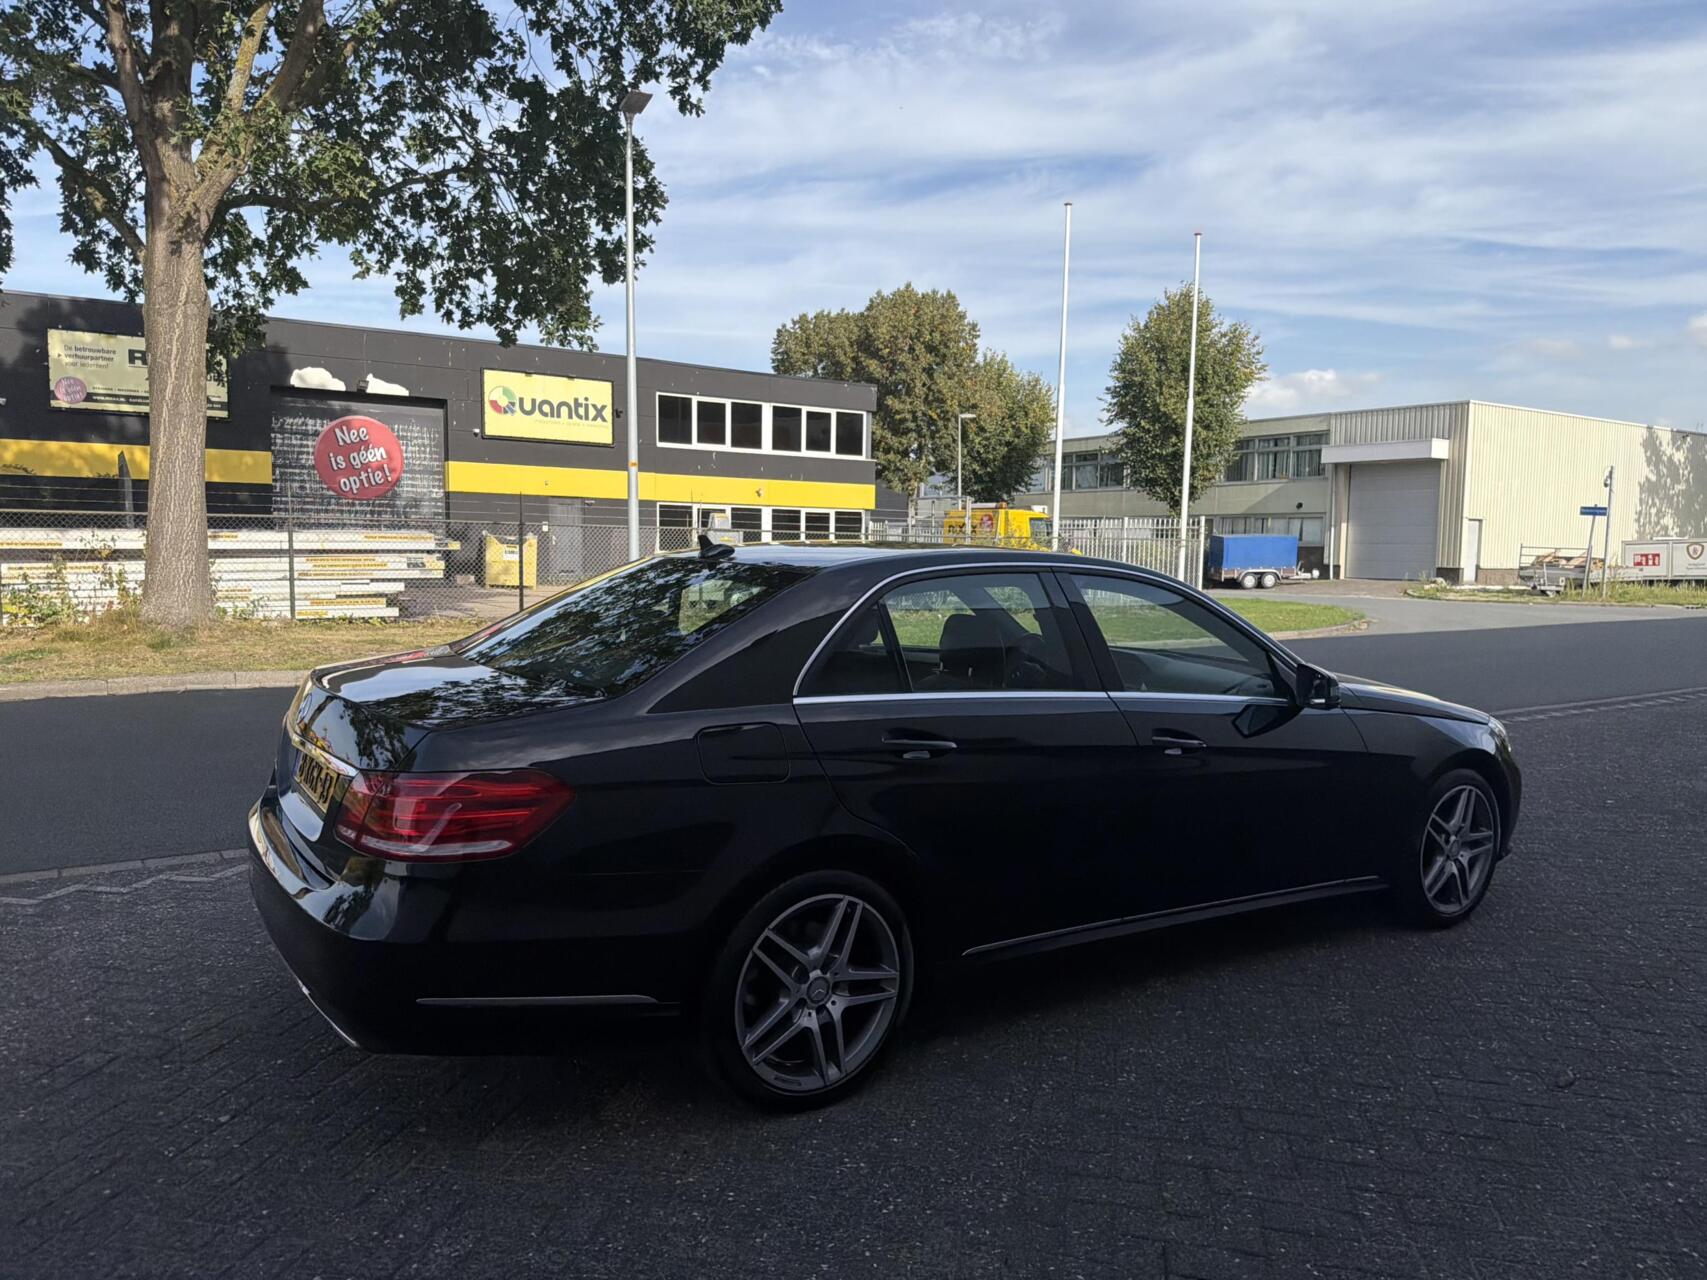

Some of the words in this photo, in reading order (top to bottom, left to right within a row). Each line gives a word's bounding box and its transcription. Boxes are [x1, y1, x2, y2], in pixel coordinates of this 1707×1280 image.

[488, 385, 608, 422] Quantix
[334, 426, 369, 446] Nee
[329, 452, 347, 470] is
[349, 444, 387, 469] géén
[340, 463, 392, 494] optie!
